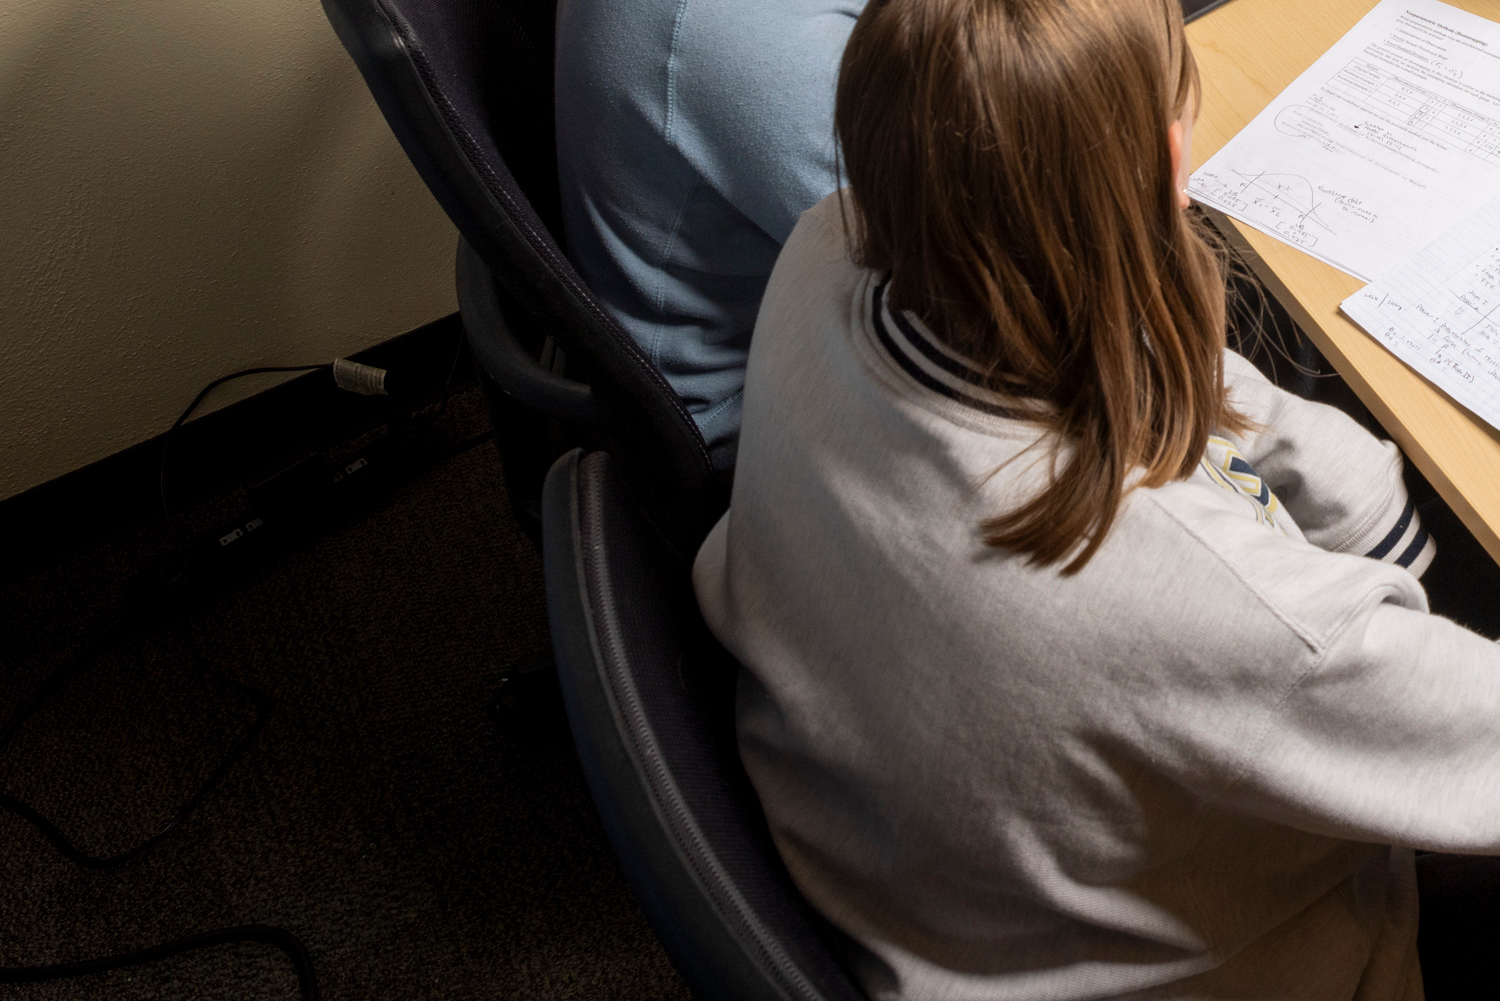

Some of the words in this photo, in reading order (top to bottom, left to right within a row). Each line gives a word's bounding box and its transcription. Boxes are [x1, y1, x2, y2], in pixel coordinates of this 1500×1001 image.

[1405, 9, 1436, 26] Nonparametric
[1436, 22, 1455, 33] Methods
[1454, 30, 1488, 47] (Bootstrapping)
[1353, 64, 1368, 74] Original
[1367, 71, 1380, 79] sample
[1479, 277, 1495, 290] FTR
